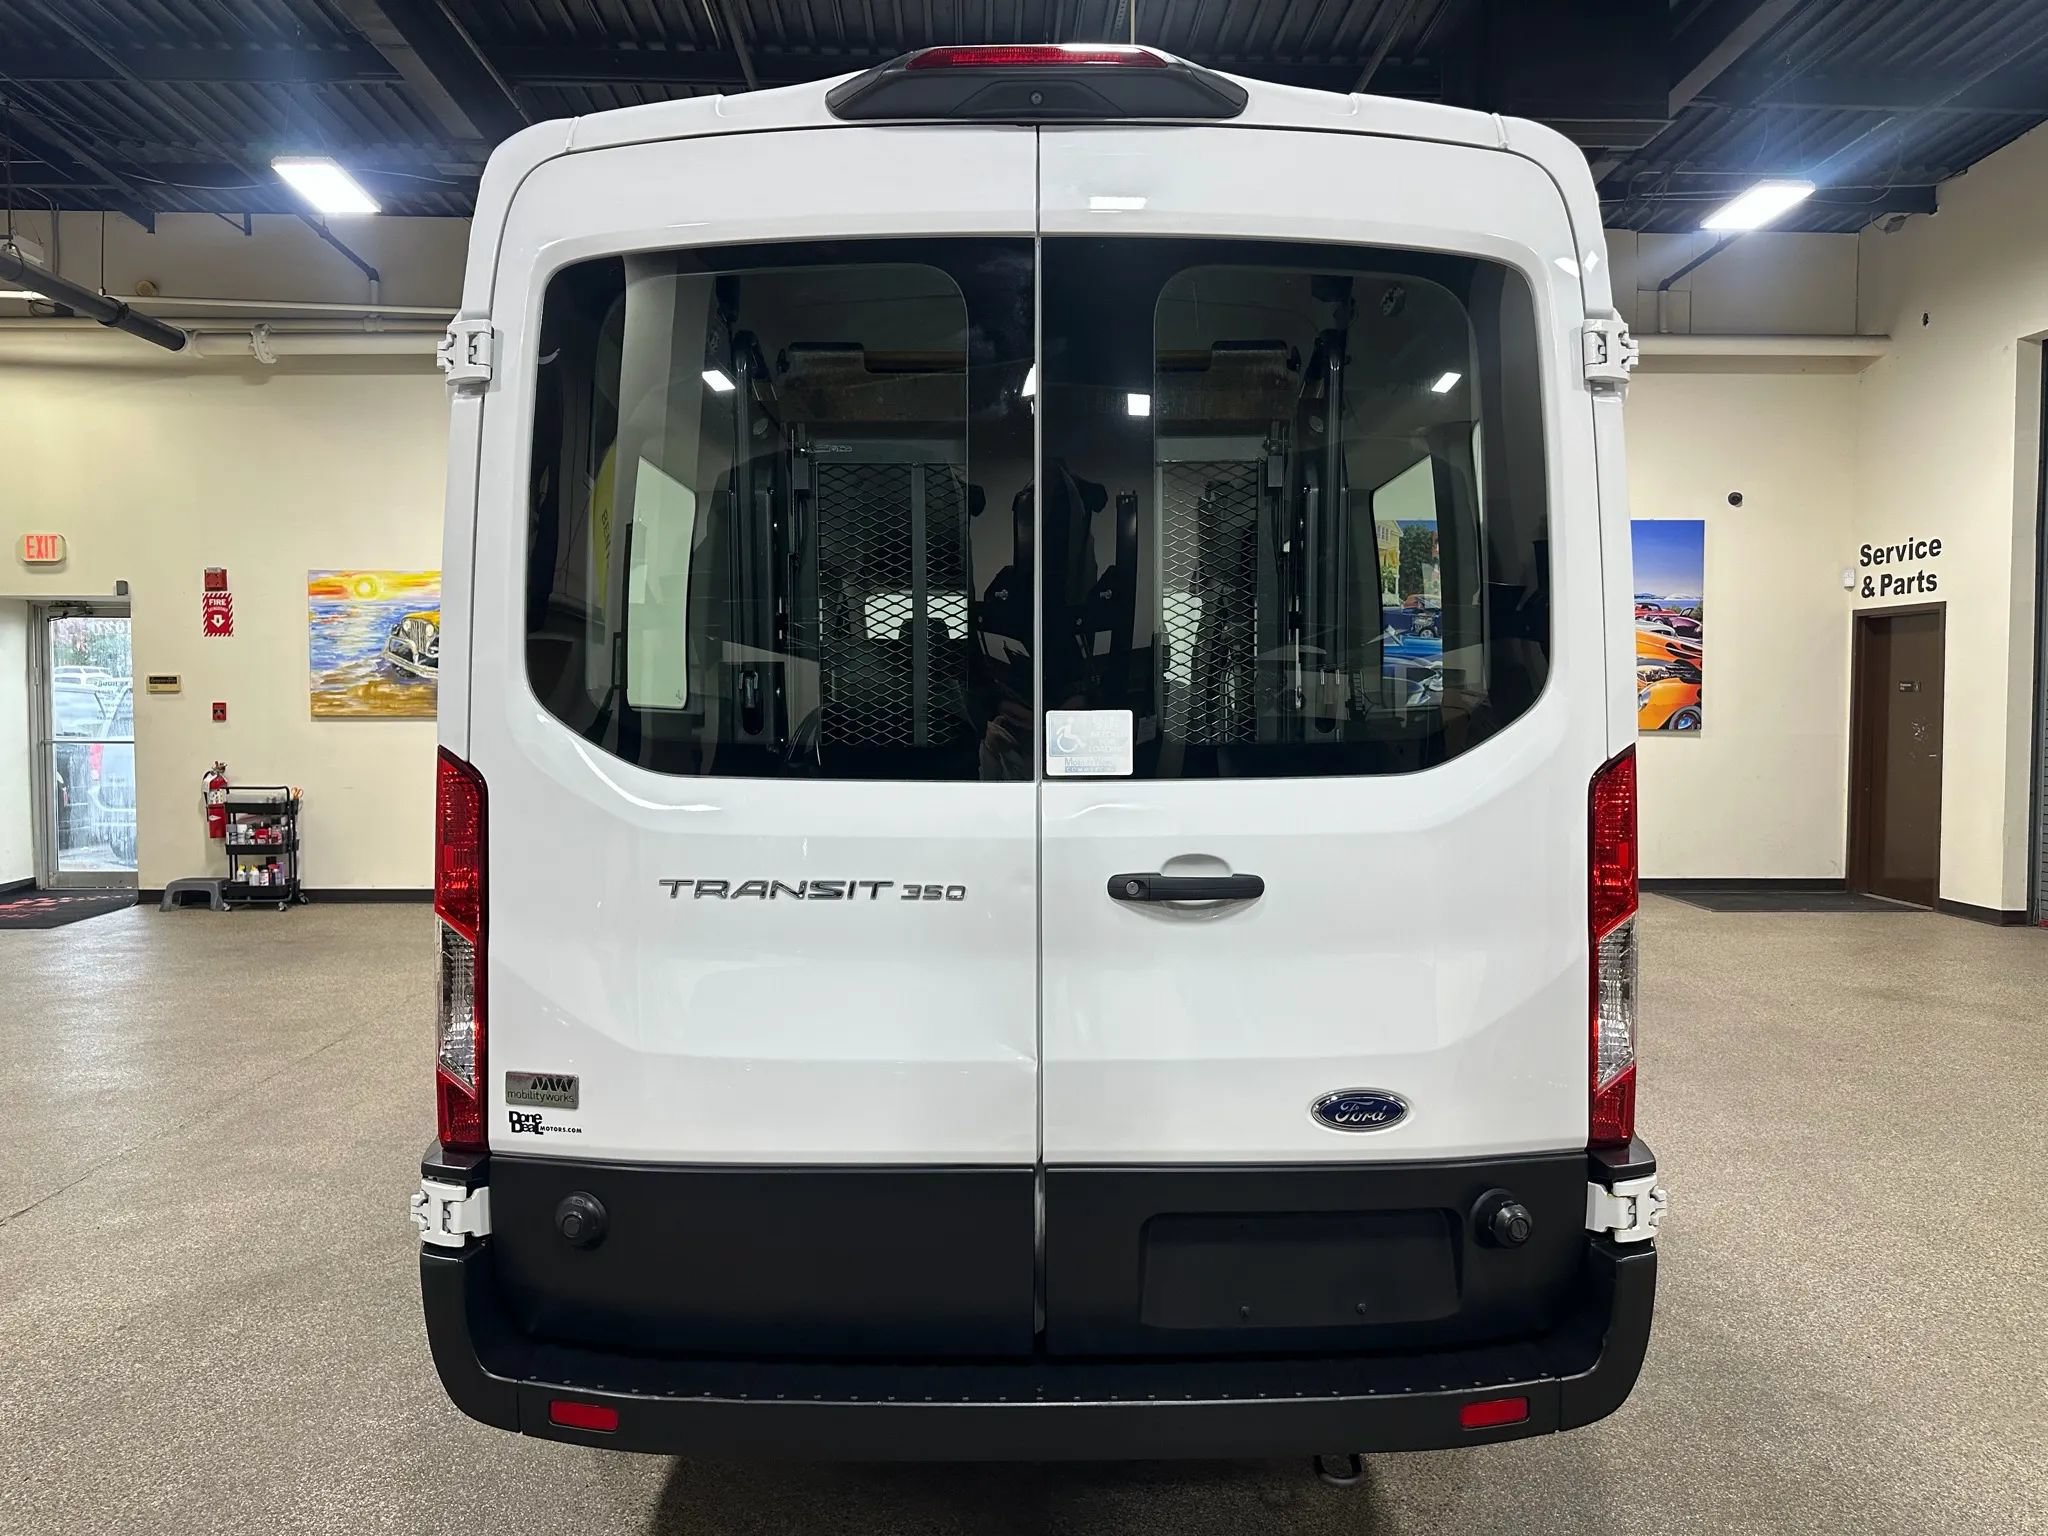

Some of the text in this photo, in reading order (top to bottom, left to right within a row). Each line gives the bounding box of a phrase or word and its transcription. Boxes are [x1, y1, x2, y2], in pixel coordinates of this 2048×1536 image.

[26, 535, 57, 560] EXIT
[1860, 537, 1942, 567] Service
[1861, 569, 1938, 599] & Parts
[658, 879, 966, 901] TRANSIT 350
[507, 1089, 574, 1102] mobilityworks
[509, 1111, 542, 1123] Done
[1335, 1100, 1387, 1121] Ford
